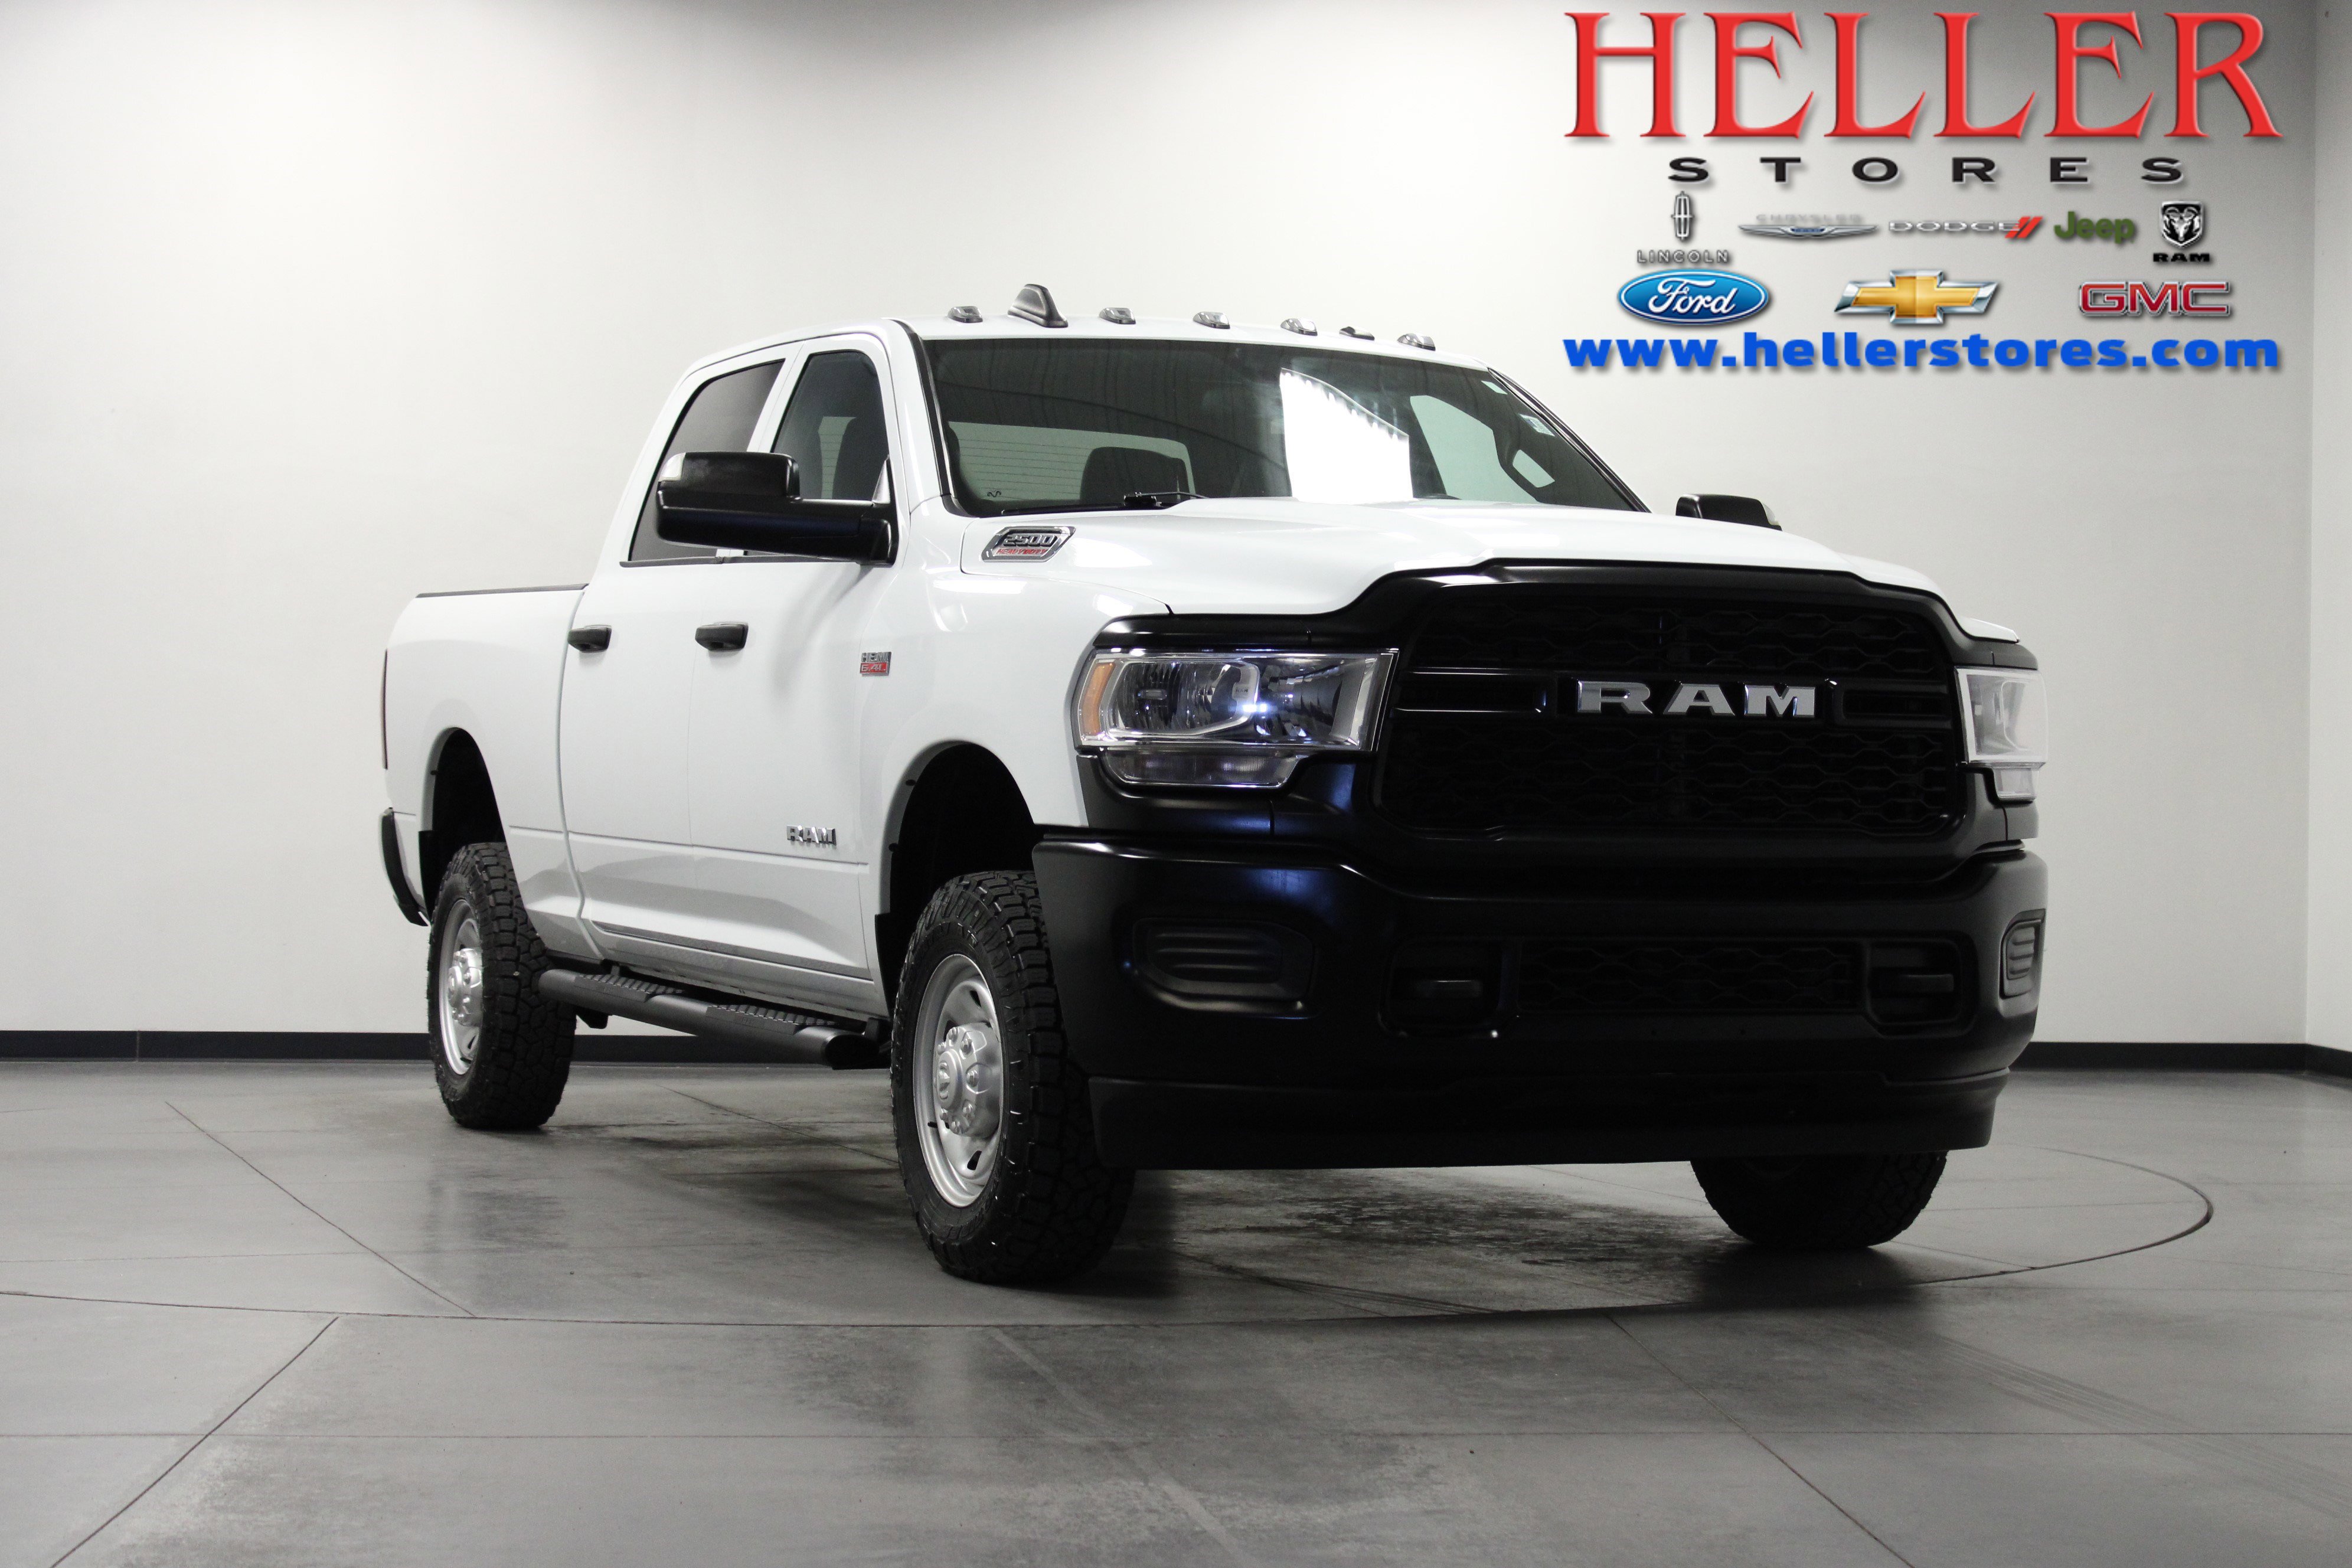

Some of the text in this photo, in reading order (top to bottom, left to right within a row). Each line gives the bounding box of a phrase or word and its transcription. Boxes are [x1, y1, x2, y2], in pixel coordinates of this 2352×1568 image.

[1003, 533, 1057, 547] 2500
[1577, 680, 1816, 718] RAM
[786, 825, 837, 845] RAM
